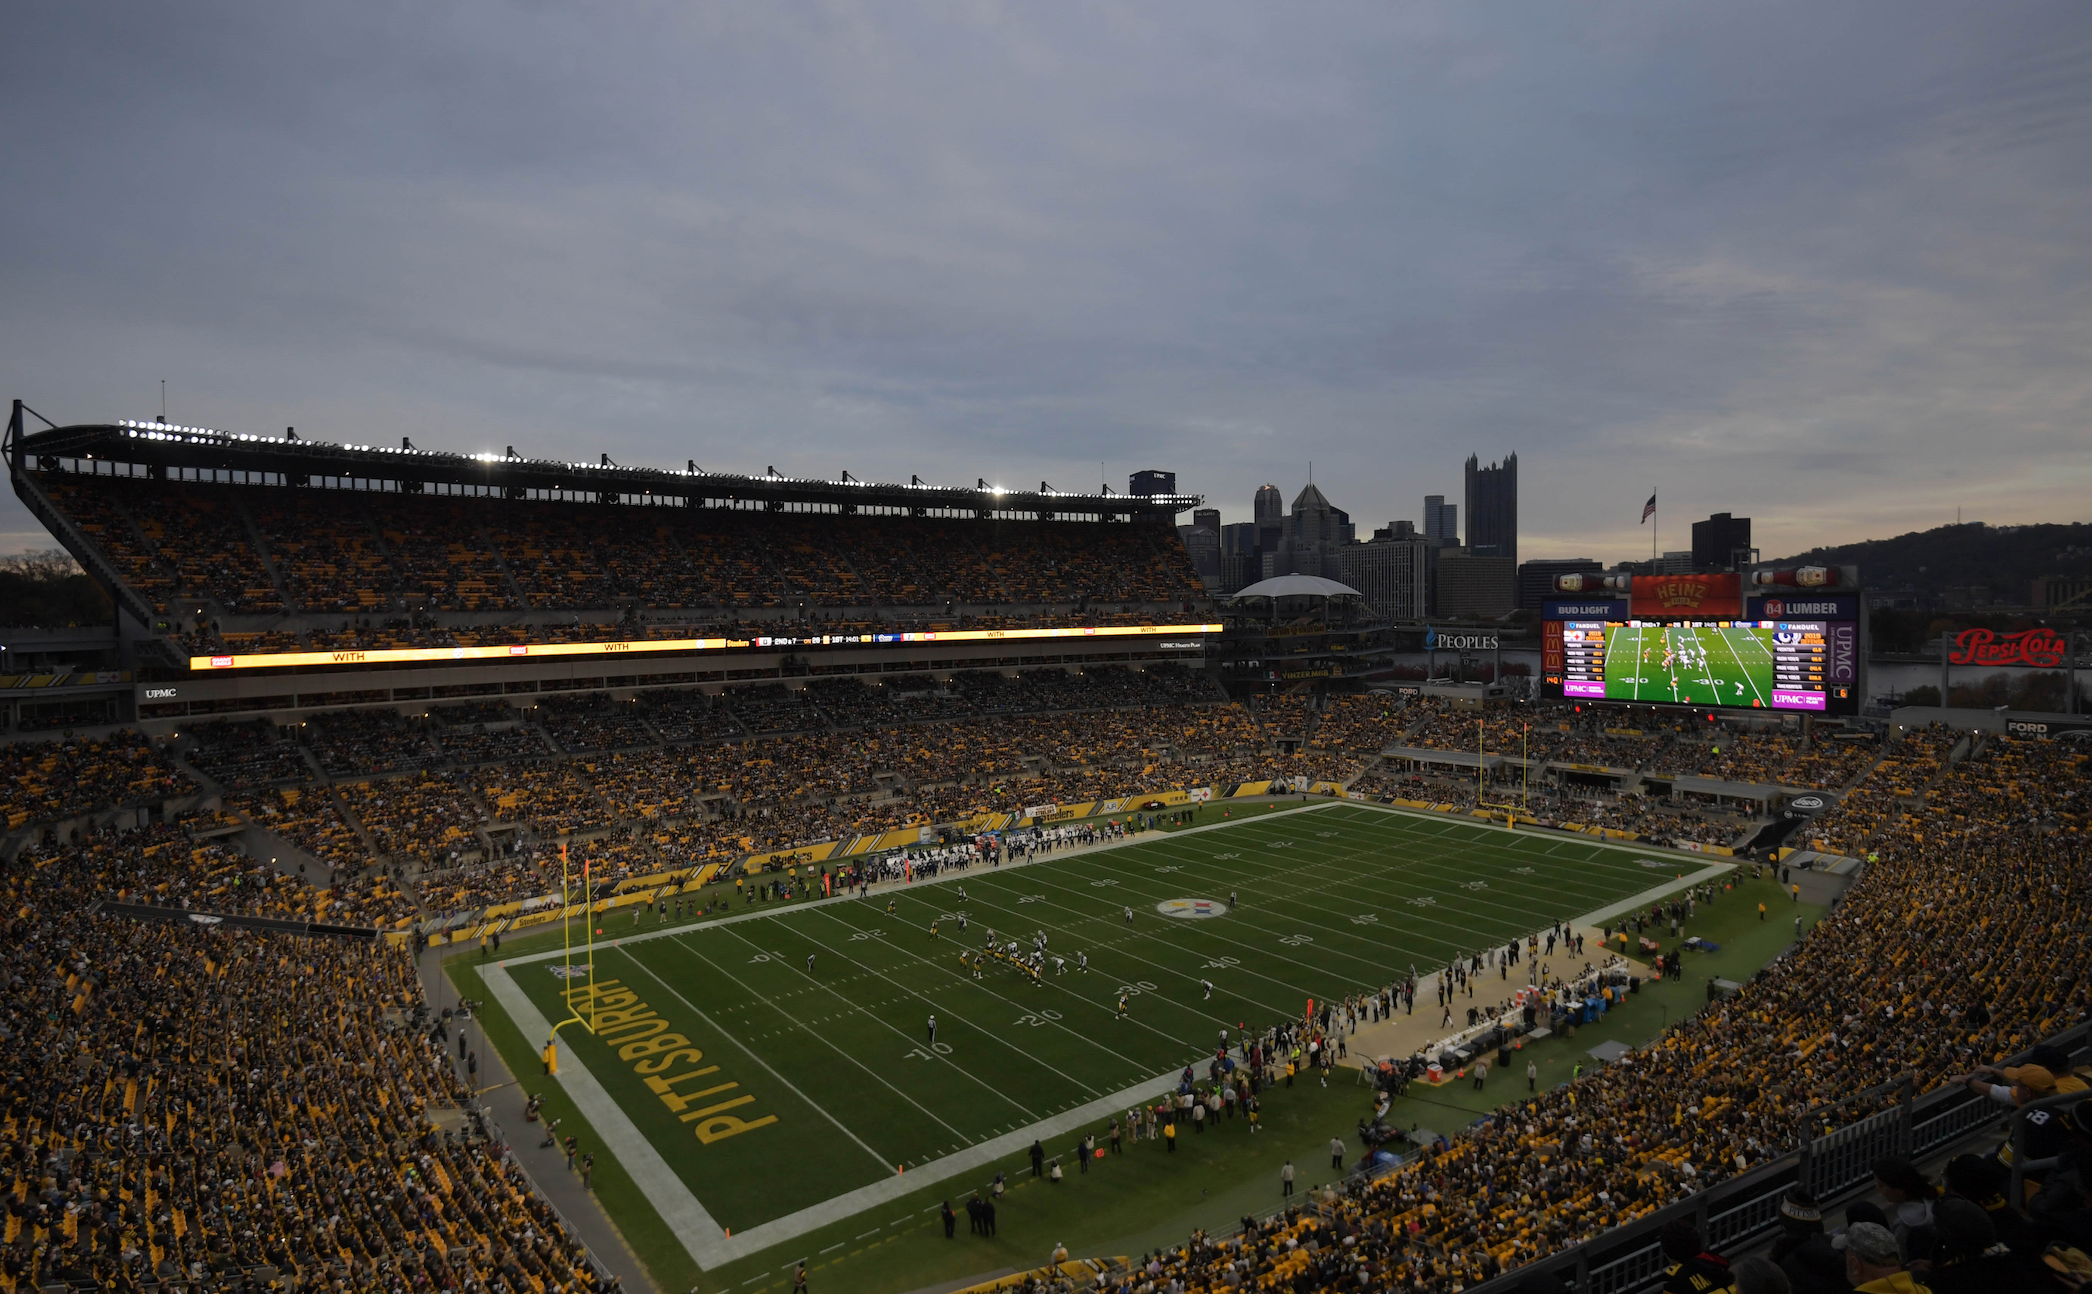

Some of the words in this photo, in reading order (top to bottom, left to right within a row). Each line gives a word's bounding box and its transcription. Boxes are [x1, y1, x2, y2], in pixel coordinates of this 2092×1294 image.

[1657, 583, 1706, 599] HEINZ
[1558, 606, 1579, 614] BUD
[1580, 606, 1609, 614] LIGHT
[1766, 603, 1781, 614] 84
[1786, 603, 1837, 614] LUMBER
[726, 639, 750, 648] Steelers
[1437, 633, 1499, 649] PEOPLES
[604, 643, 629, 651] WITH
[1836, 626, 1853, 679] UPMC
[332, 653, 365, 661] WITH
[145, 688, 177, 699] UPMC
[1398, 687, 1418, 696] FORD
[1840, 689, 1847, 698] 6
[1773, 695, 1804, 704] UPMC
[2008, 722, 2048, 733] FORD
[519, 916, 547, 927] Steelers
[854, 928, 887, 941] 20
[1279, 934, 1314, 946] 50
[752, 950, 787, 963] 10
[1211, 956, 1242, 970] 40
[1120, 980, 1159, 996] 30
[1021, 1009, 1063, 1027] 20
[911, 1042, 954, 1061] 10
[559, 979, 780, 1145] PITTSBURGH
